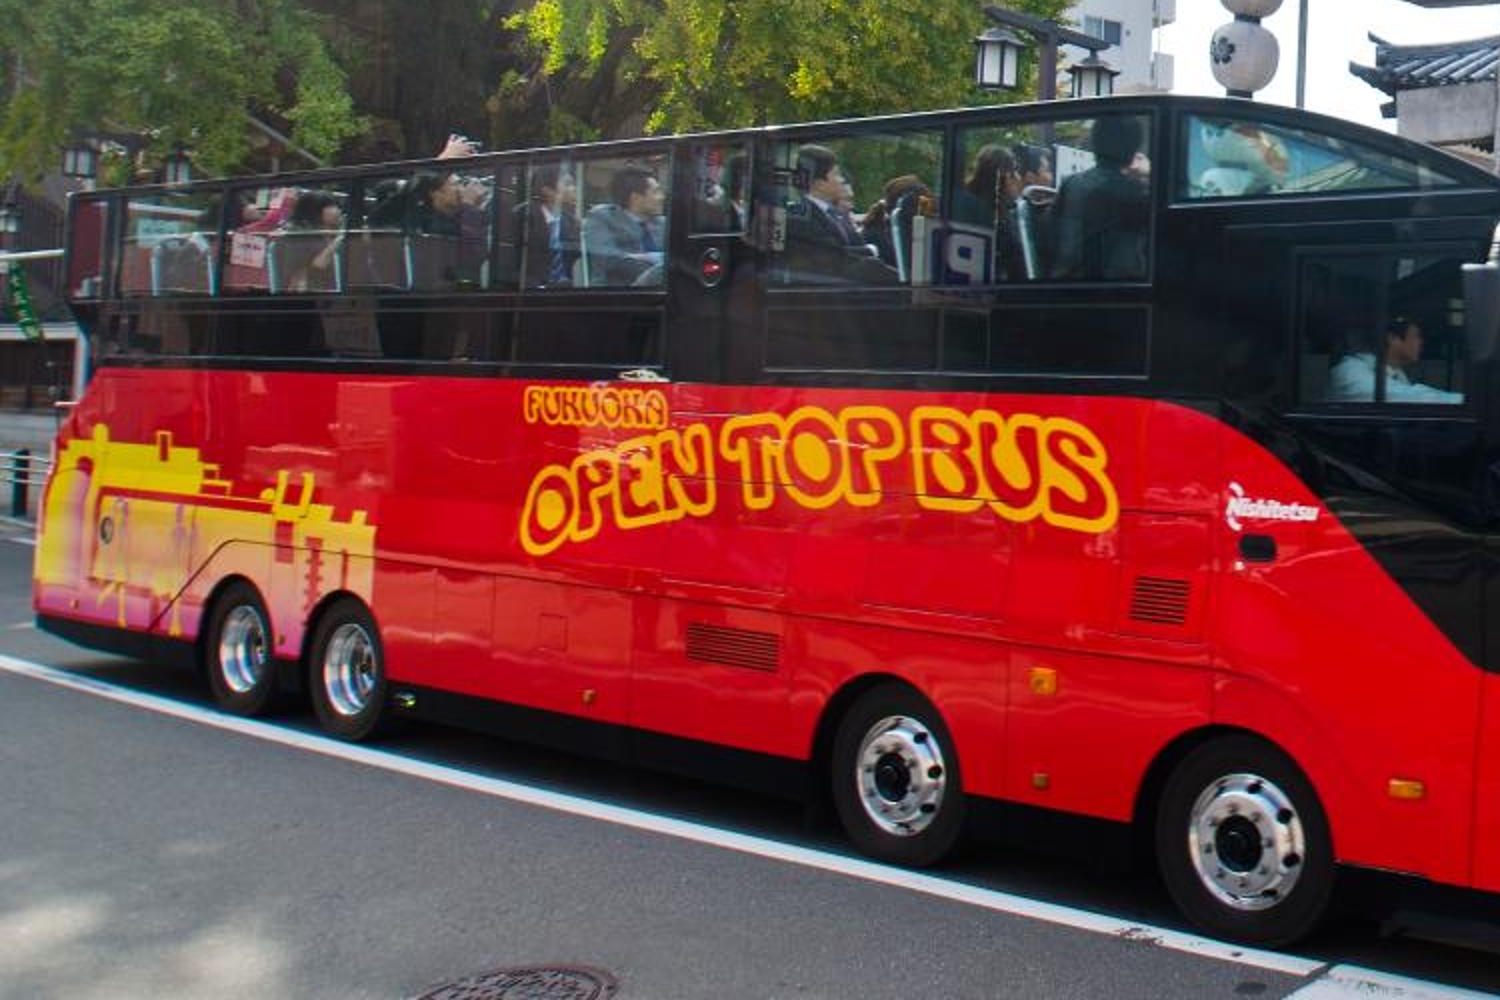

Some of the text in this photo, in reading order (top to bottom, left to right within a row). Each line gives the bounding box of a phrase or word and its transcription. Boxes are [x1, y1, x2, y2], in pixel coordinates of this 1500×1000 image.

[524, 386, 669, 430] FUKUOKA
[519, 405, 1119, 556] OPEN TOP BUS
[1226, 496, 1320, 521] Nishitetsu
